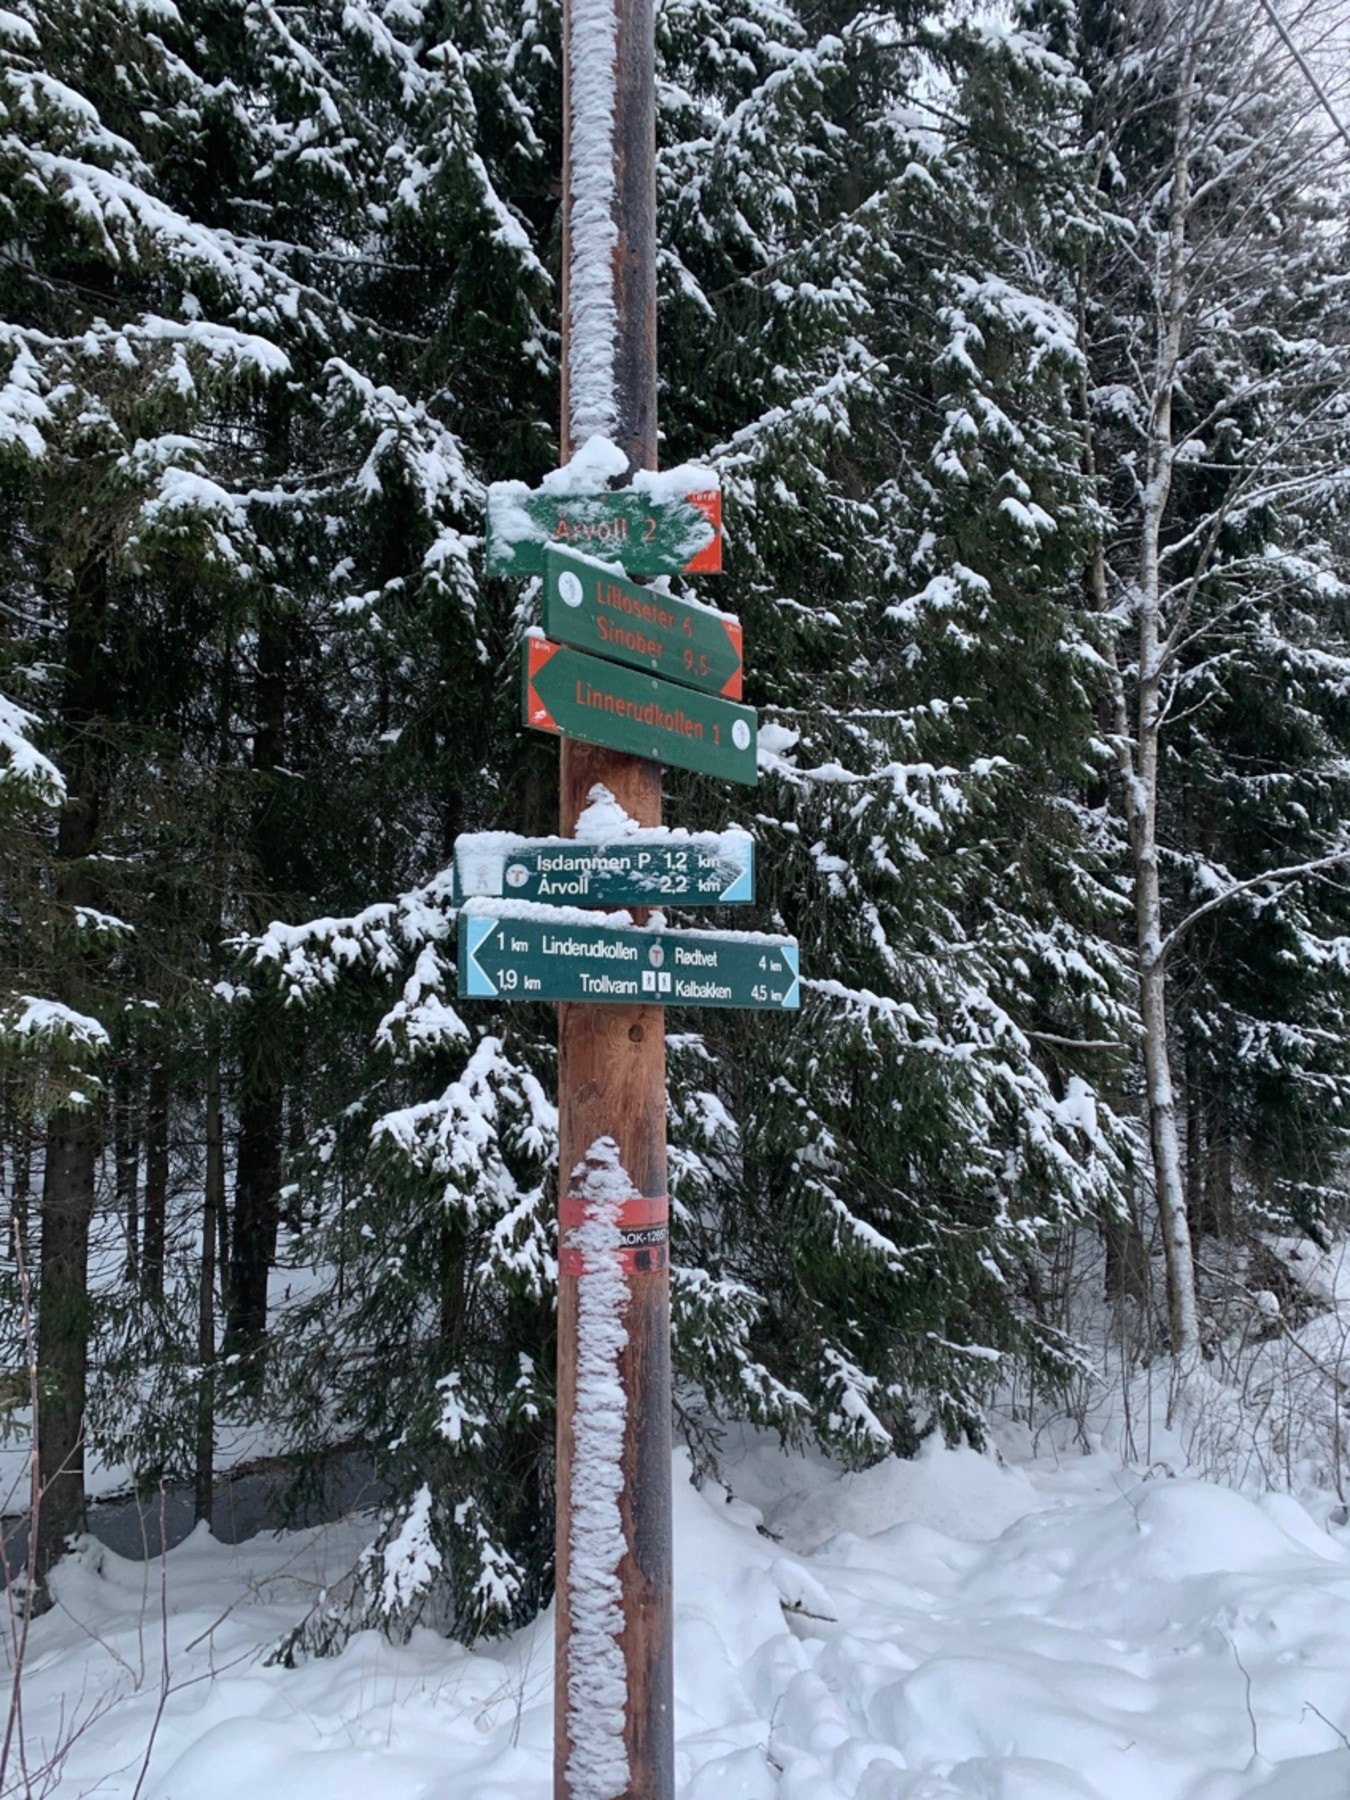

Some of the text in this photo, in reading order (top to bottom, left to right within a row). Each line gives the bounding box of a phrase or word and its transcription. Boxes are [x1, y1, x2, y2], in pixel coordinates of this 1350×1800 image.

[643, 517, 657, 540] 2
[596, 580, 693, 638] Lilloseter 6
[596, 615, 708, 677] Sinober 9,5
[575, 679, 721, 745] Linnerudkollen 1
[536, 853, 631, 871] Isdammen
[638, 852, 652, 870] P
[663, 851, 688, 870] 1,2
[537, 873, 721, 895] Årvoll 2,2 km
[497, 931, 639, 961] 1 km Linderudkollen
[675, 946, 782, 972] Rødtvet 4 km
[497, 968, 639, 995] 1,9 km Trollvann
[675, 979, 783, 1002] Kalbakken 4,5 km
